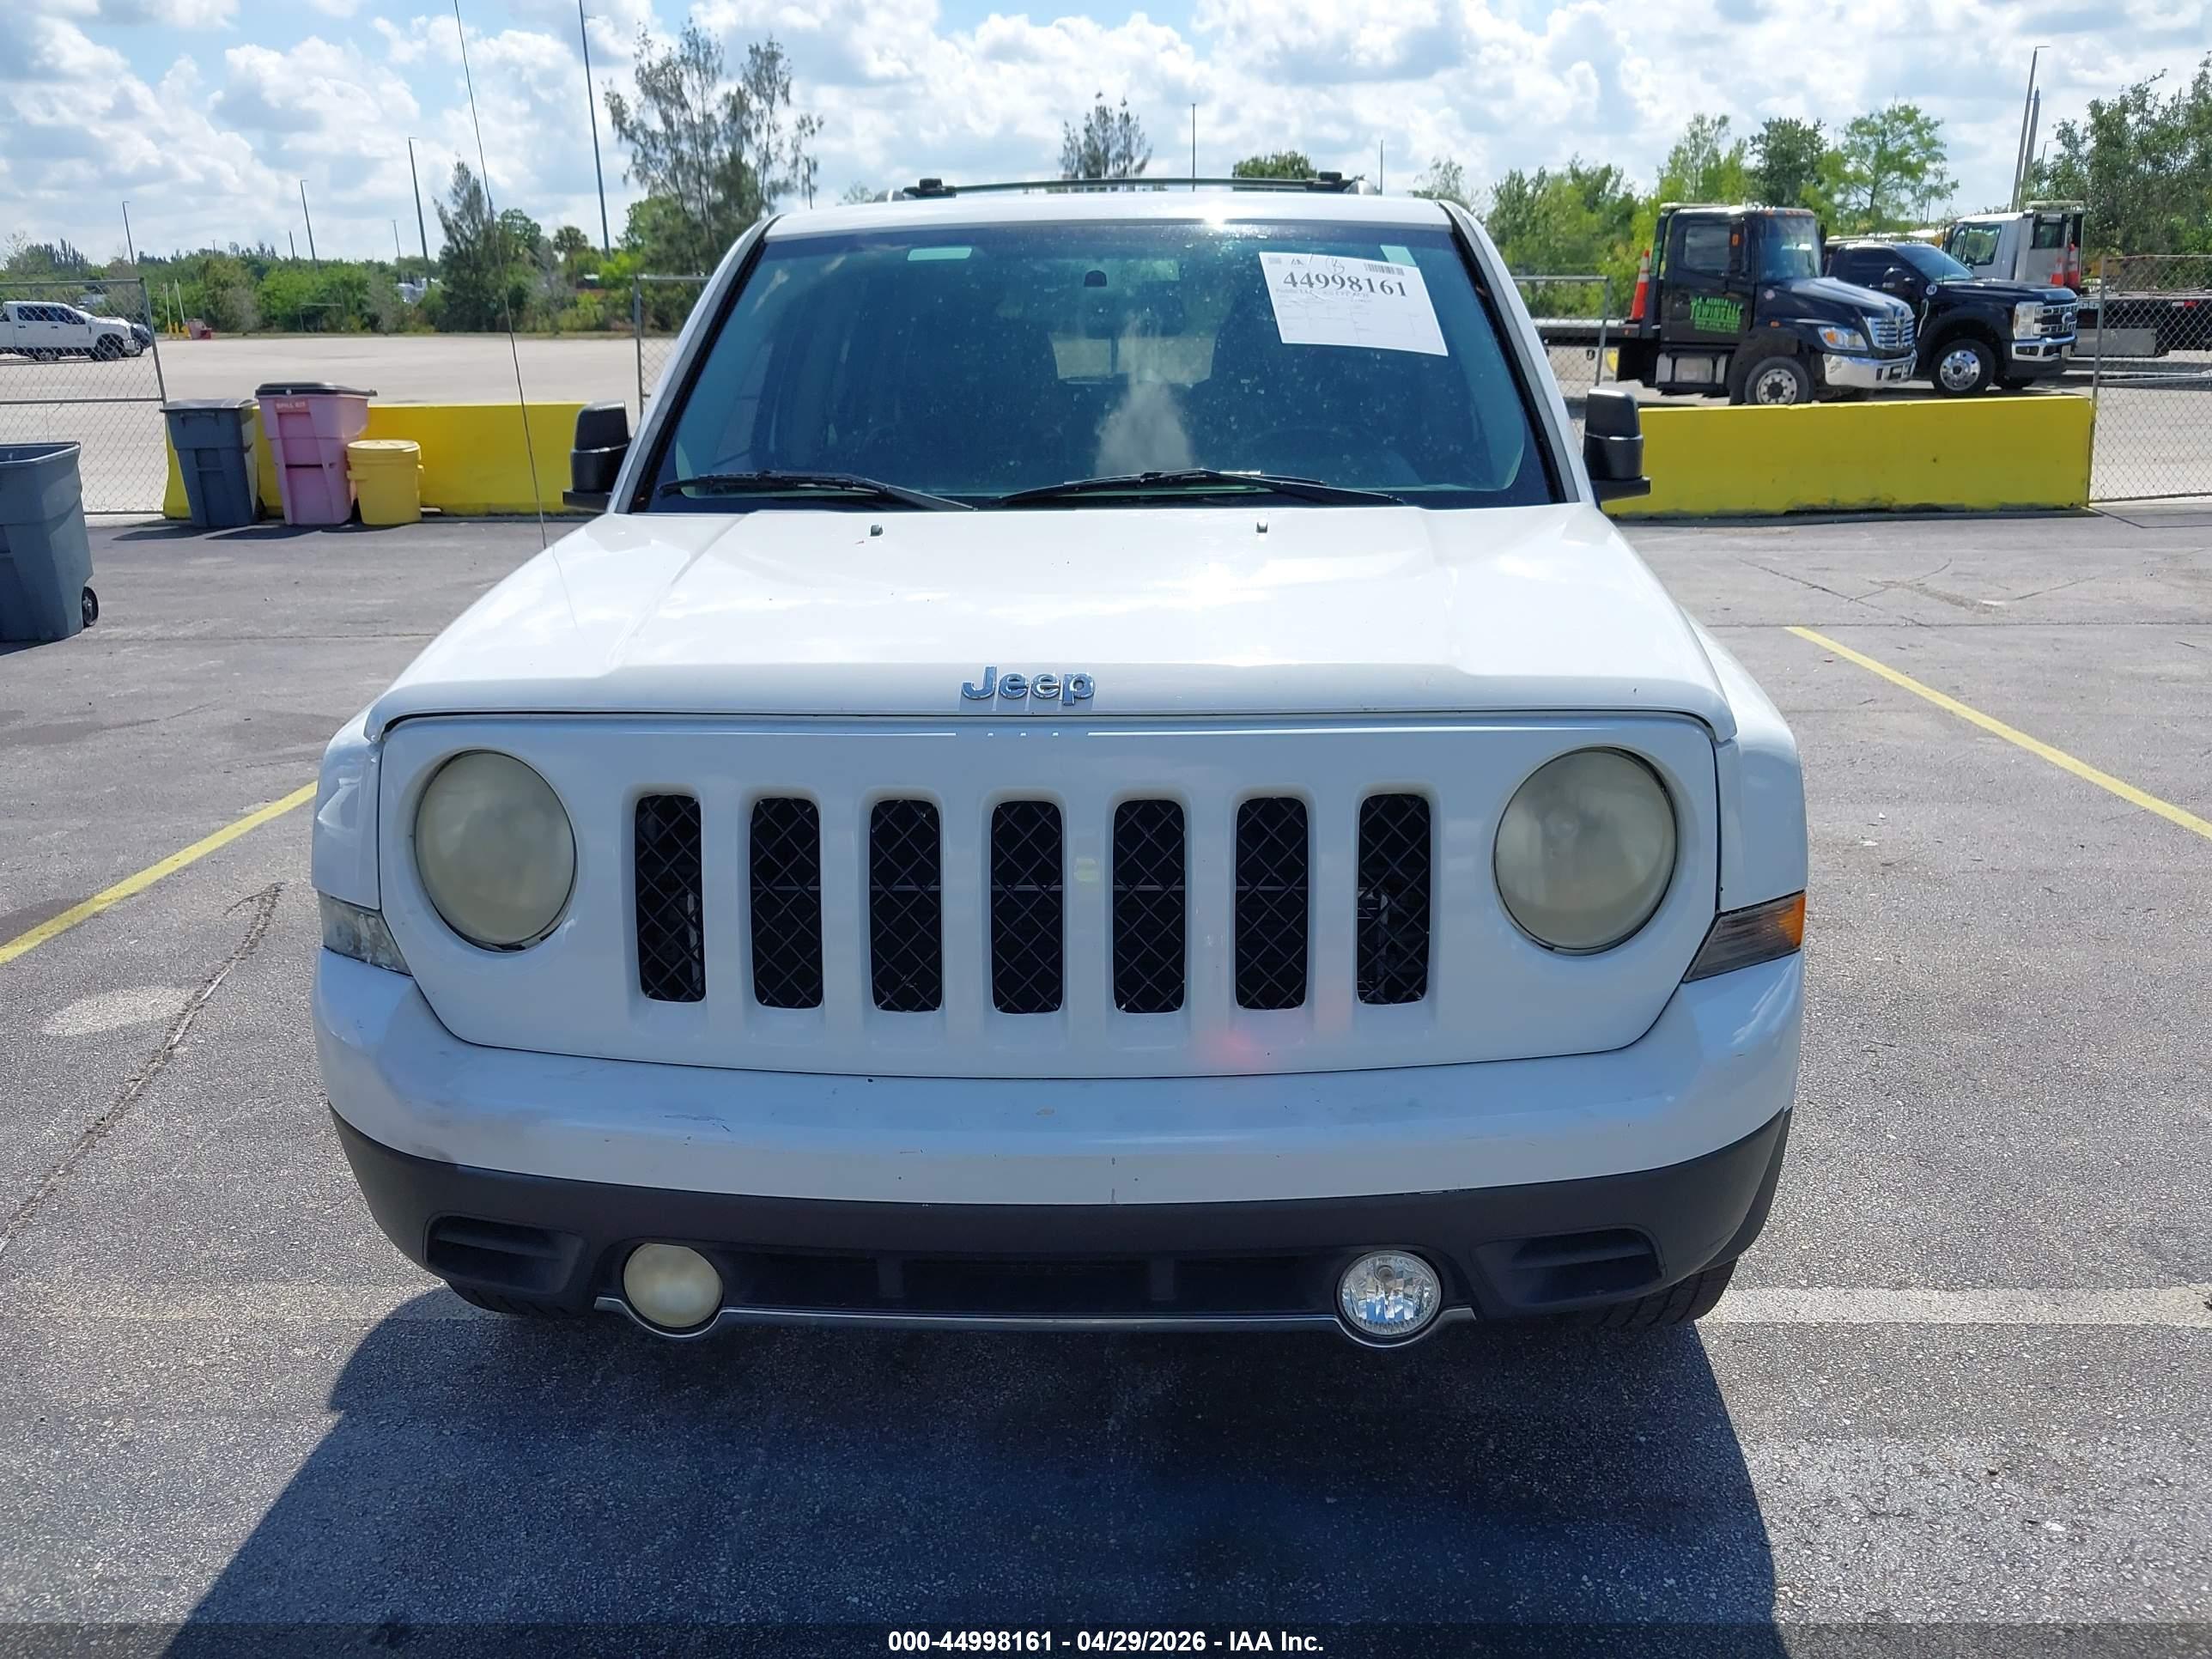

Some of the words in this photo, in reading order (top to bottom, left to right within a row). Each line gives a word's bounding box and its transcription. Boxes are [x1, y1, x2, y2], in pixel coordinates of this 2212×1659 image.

[1283, 271, 1407, 297] 44998161
[1690, 301, 1725, 320] TOWING
[961, 665, 1096, 706] Jeep
